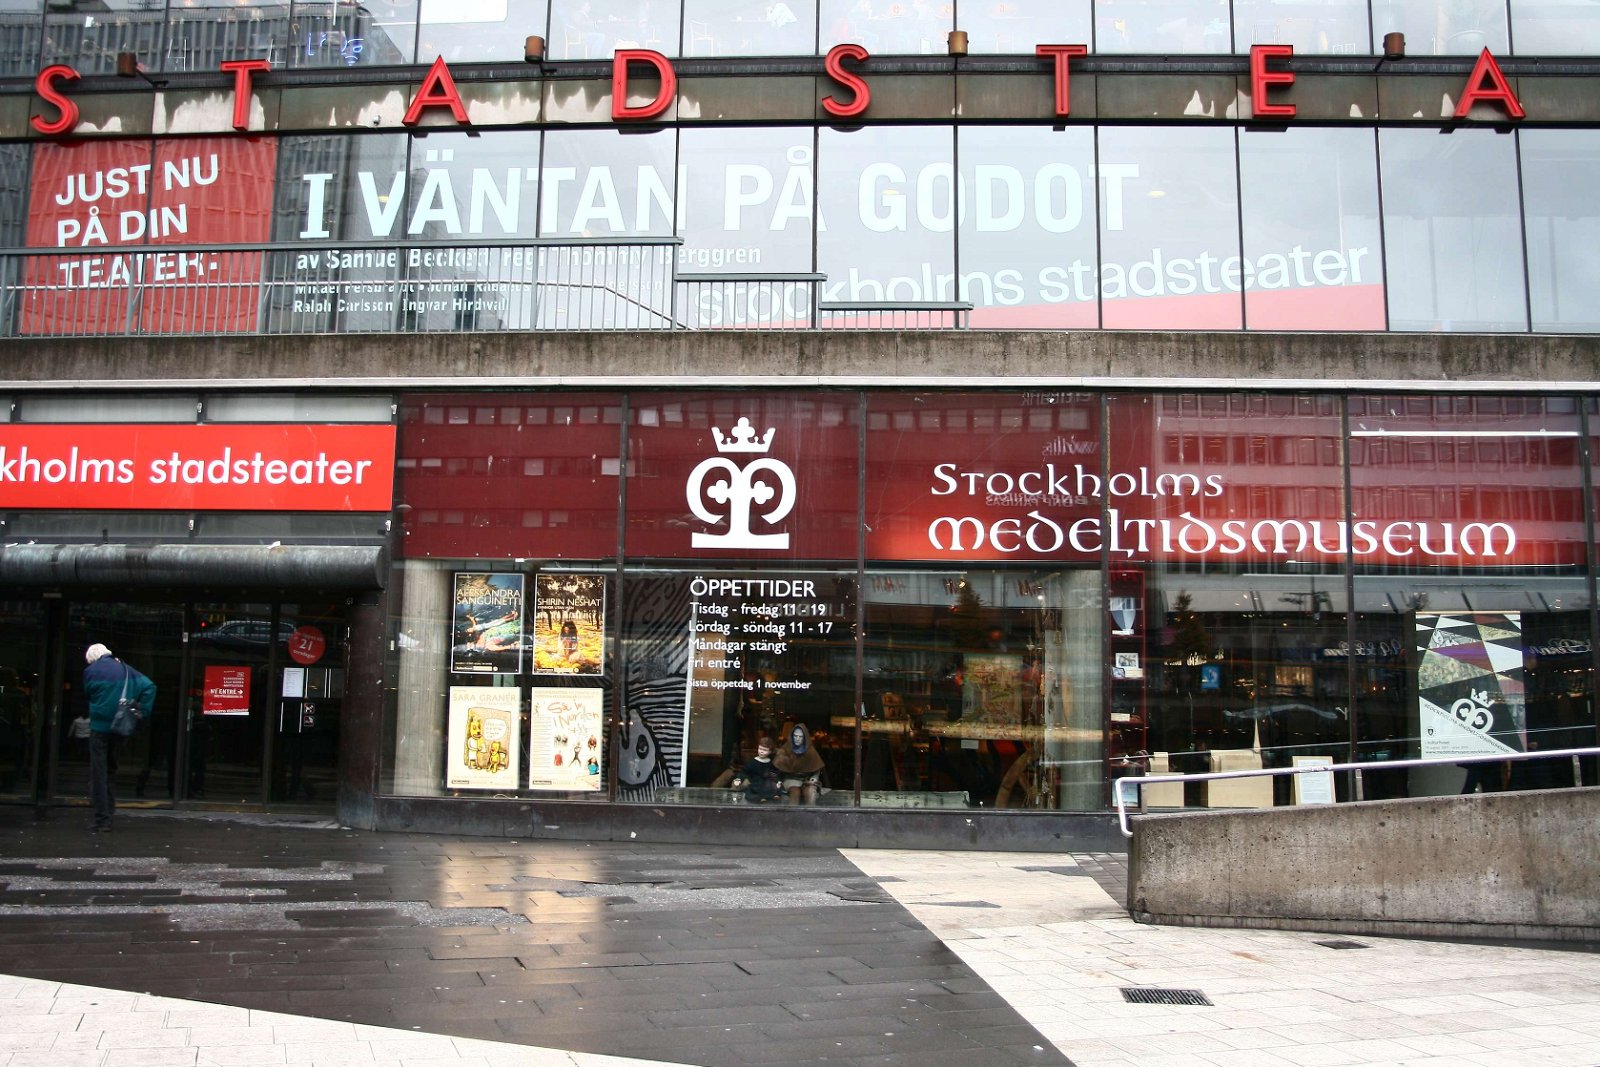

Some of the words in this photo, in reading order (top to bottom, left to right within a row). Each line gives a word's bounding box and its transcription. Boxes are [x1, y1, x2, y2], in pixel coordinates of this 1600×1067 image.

[55, 164, 151, 205] JUST
[164, 153, 218, 191] NU
[299, 173, 333, 239] I
[358, 149, 688, 238] VÄNTAN
[723, 145, 828, 233] PÅ
[858, 161, 1140, 233] GODOT
[57, 206, 109, 248] PÅ
[120, 204, 187, 241] DIN
[297, 254, 319, 269] av
[327, 249, 397, 269] Samue
[409, 248, 492, 267] Beckett
[659, 247, 761, 268] Berggren
[1040, 244, 1368, 304] stadsteater
[294, 299, 332, 314] Ralph
[338, 299, 393, 312] Carlsson
[402, 299, 447, 313] Ingvar
[0, 446, 134, 483] kholms
[149, 446, 372, 485] stadsteater
[689, 575, 816, 598] ÖPPETTIDER
[537, 598, 566, 606] SHIRIN
[567, 598, 601, 607] NESHAT
[689, 602, 729, 617] Tisdag
[740, 602, 779, 618] fredag
[782, 604, 796, 616] 11
[810, 604, 826, 616] 19
[688, 620, 731, 636] Lördag
[743, 620, 786, 637] söndag
[789, 622, 803, 634] 11
[817, 622, 833, 634] 17
[688, 637, 747, 654] Måndagar
[750, 639, 787, 654] stängt
[707, 656, 741, 669] entré
[710, 678, 754, 691] öppetdag
[756, 679, 762, 688] 1
[764, 679, 812, 690] november
